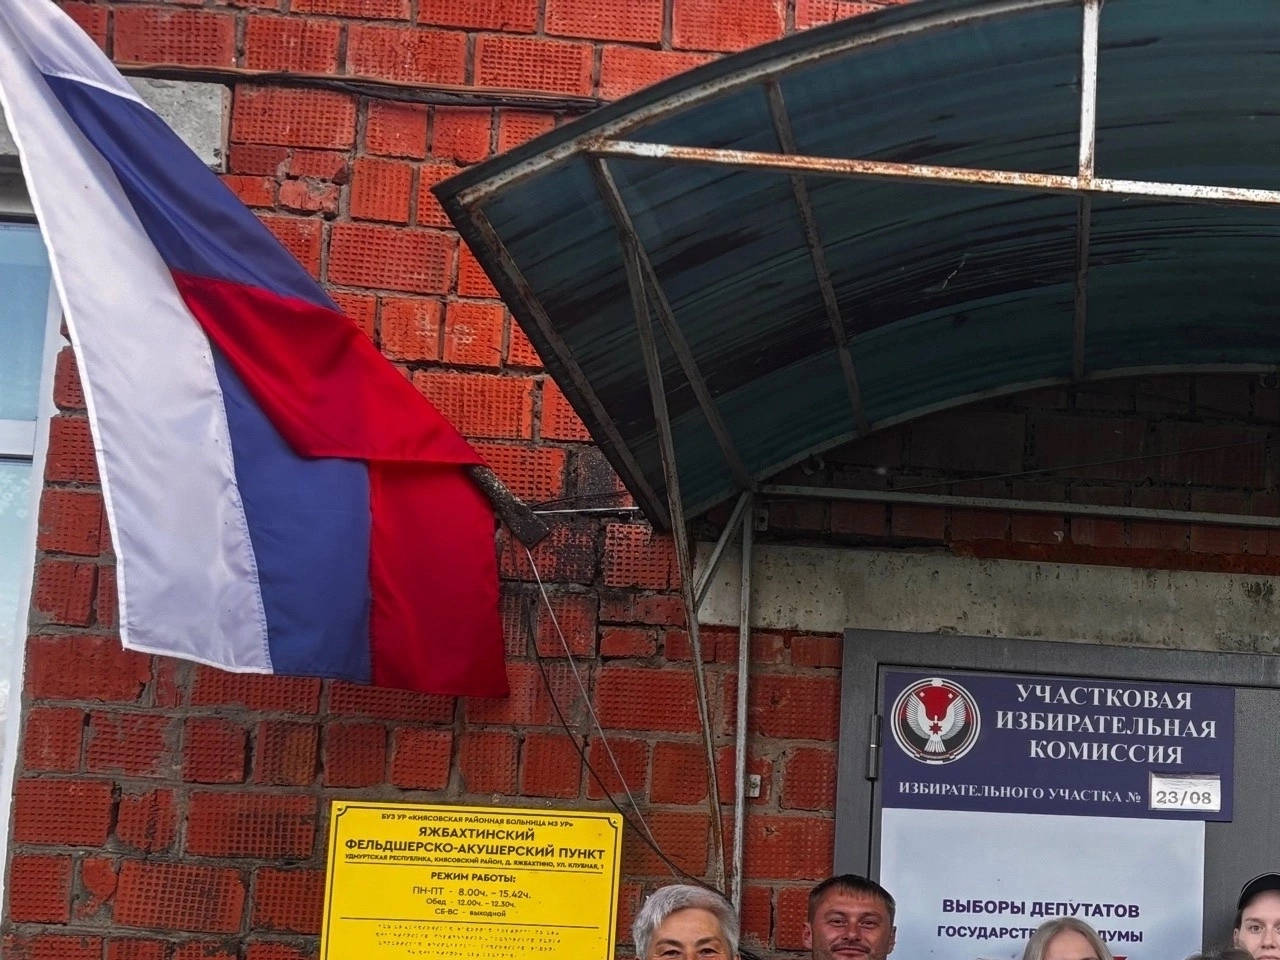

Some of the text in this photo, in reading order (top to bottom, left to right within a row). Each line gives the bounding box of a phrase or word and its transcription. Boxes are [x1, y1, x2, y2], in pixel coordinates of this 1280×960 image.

[1016, 683, 1192, 710] УЧАСТКОВАЯ
[995, 710, 1217, 738] ИЗБИРАТЕЛЬНАЯ
[1029, 740, 1183, 764] КОМИССИЯ
[899, 781, 1212, 805] ИЗБИРАТЕЛЬНОГО УЧАСТКА № 23/08
[408, 815, 463, 823] «КИЯСОВСКАЯ
[464, 816, 504, 825] РАЙОННАЯ
[506, 818, 546, 827] БОЛЬНИЦА
[419, 826, 535, 841] ЯЖБАХТИНСКИЙ
[345, 839, 605, 859] ФЕЛЬДШЕРСКО-АКУШЕРСКИЙ ПУНКТ
[389, 855, 433, 863] РЕСПУБЛИКА,
[480, 858, 504, 866] РАЙОН,
[431, 871, 516, 883] РЕЖИМ РАБОТЫ:
[413, 886, 444, 895] ПН-ПТ
[458, 888, 488, 897] 8.00ч.
[499, 890, 531, 899] 15.42ч.
[426, 897, 446, 906] Обед
[457, 899, 483, 907] 12.00ч.
[942, 899, 1140, 918] ВЫБОРЫ ДЕПУТАТОВ
[435, 907, 459, 915] СБ-ВС
[469, 909, 506, 918] выходной
[937, 925, 1143, 943] ГОСУДАРСТ ДУМЫ
